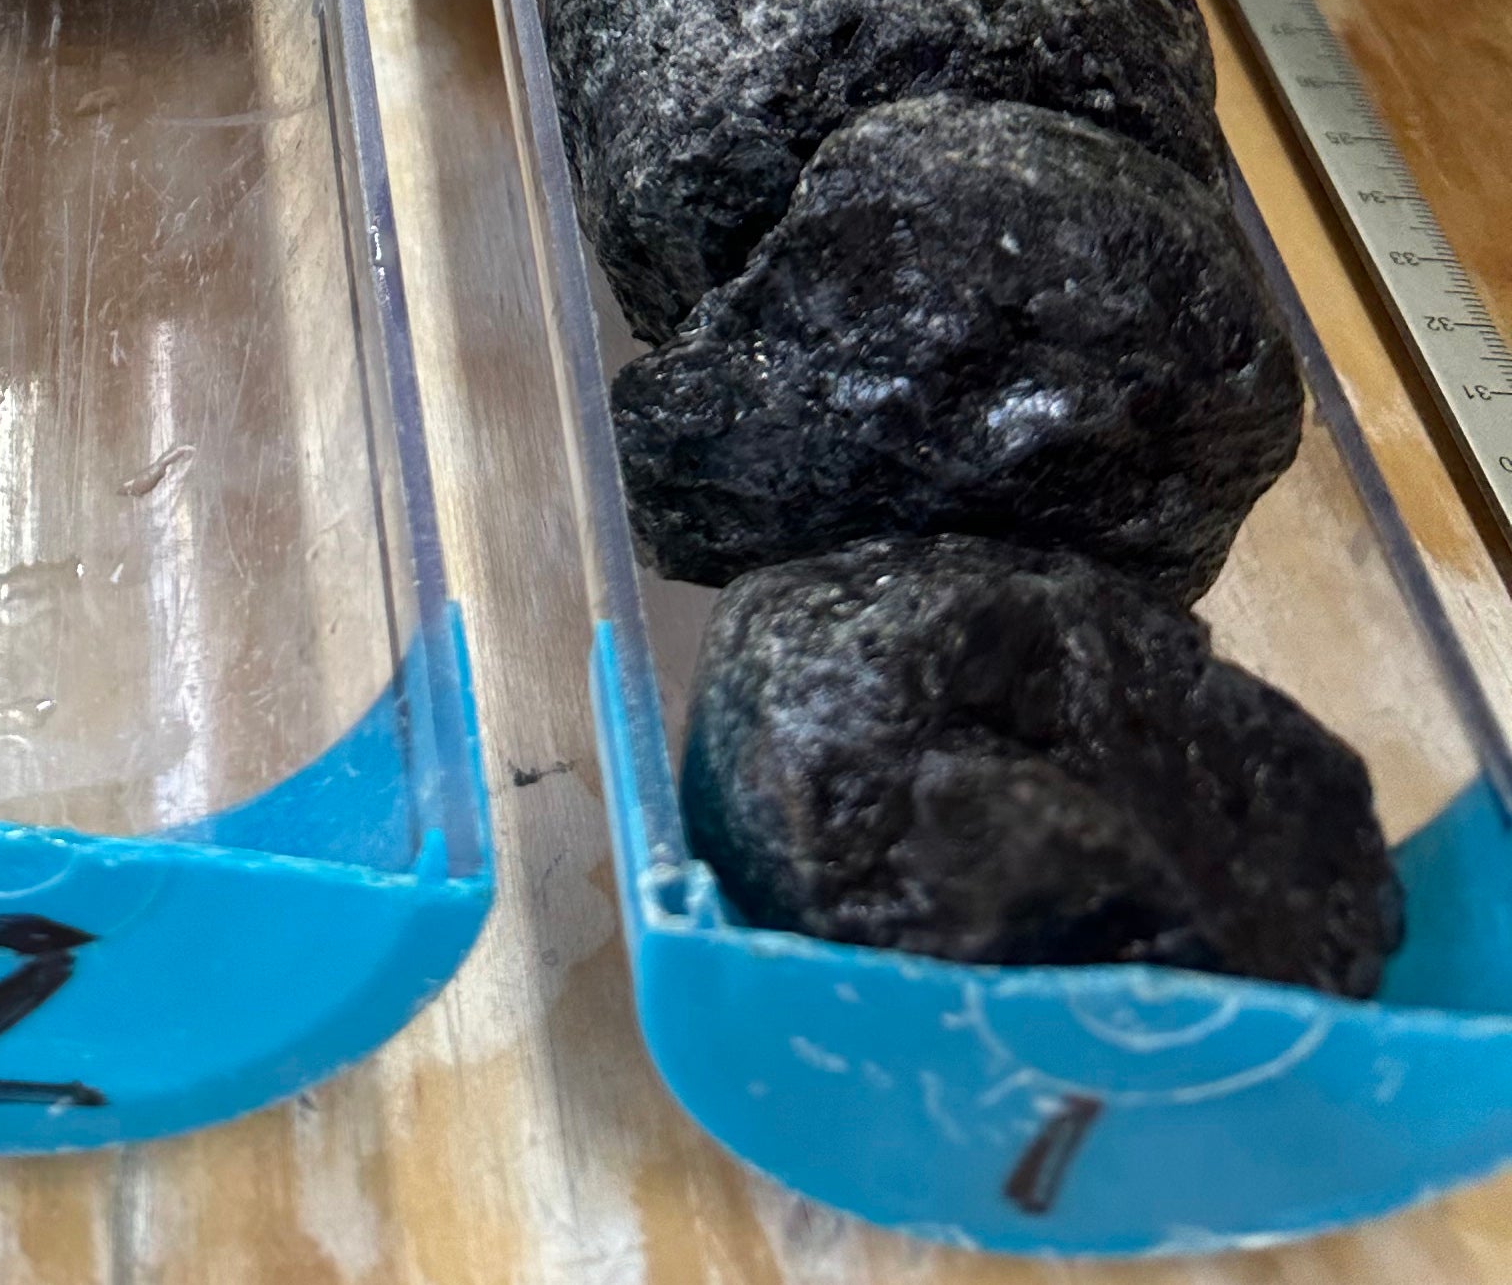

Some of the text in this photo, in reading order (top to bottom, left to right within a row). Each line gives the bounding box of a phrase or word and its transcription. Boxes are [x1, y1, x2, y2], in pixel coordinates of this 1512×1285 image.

[1357, 190, 1386, 203] 34
[1389, 251, 1423, 266] 33
[1423, 315, 1455, 332] 32
[1462, 384, 1492, 401] 31
[1002, 1094, 1103, 1214] 1
